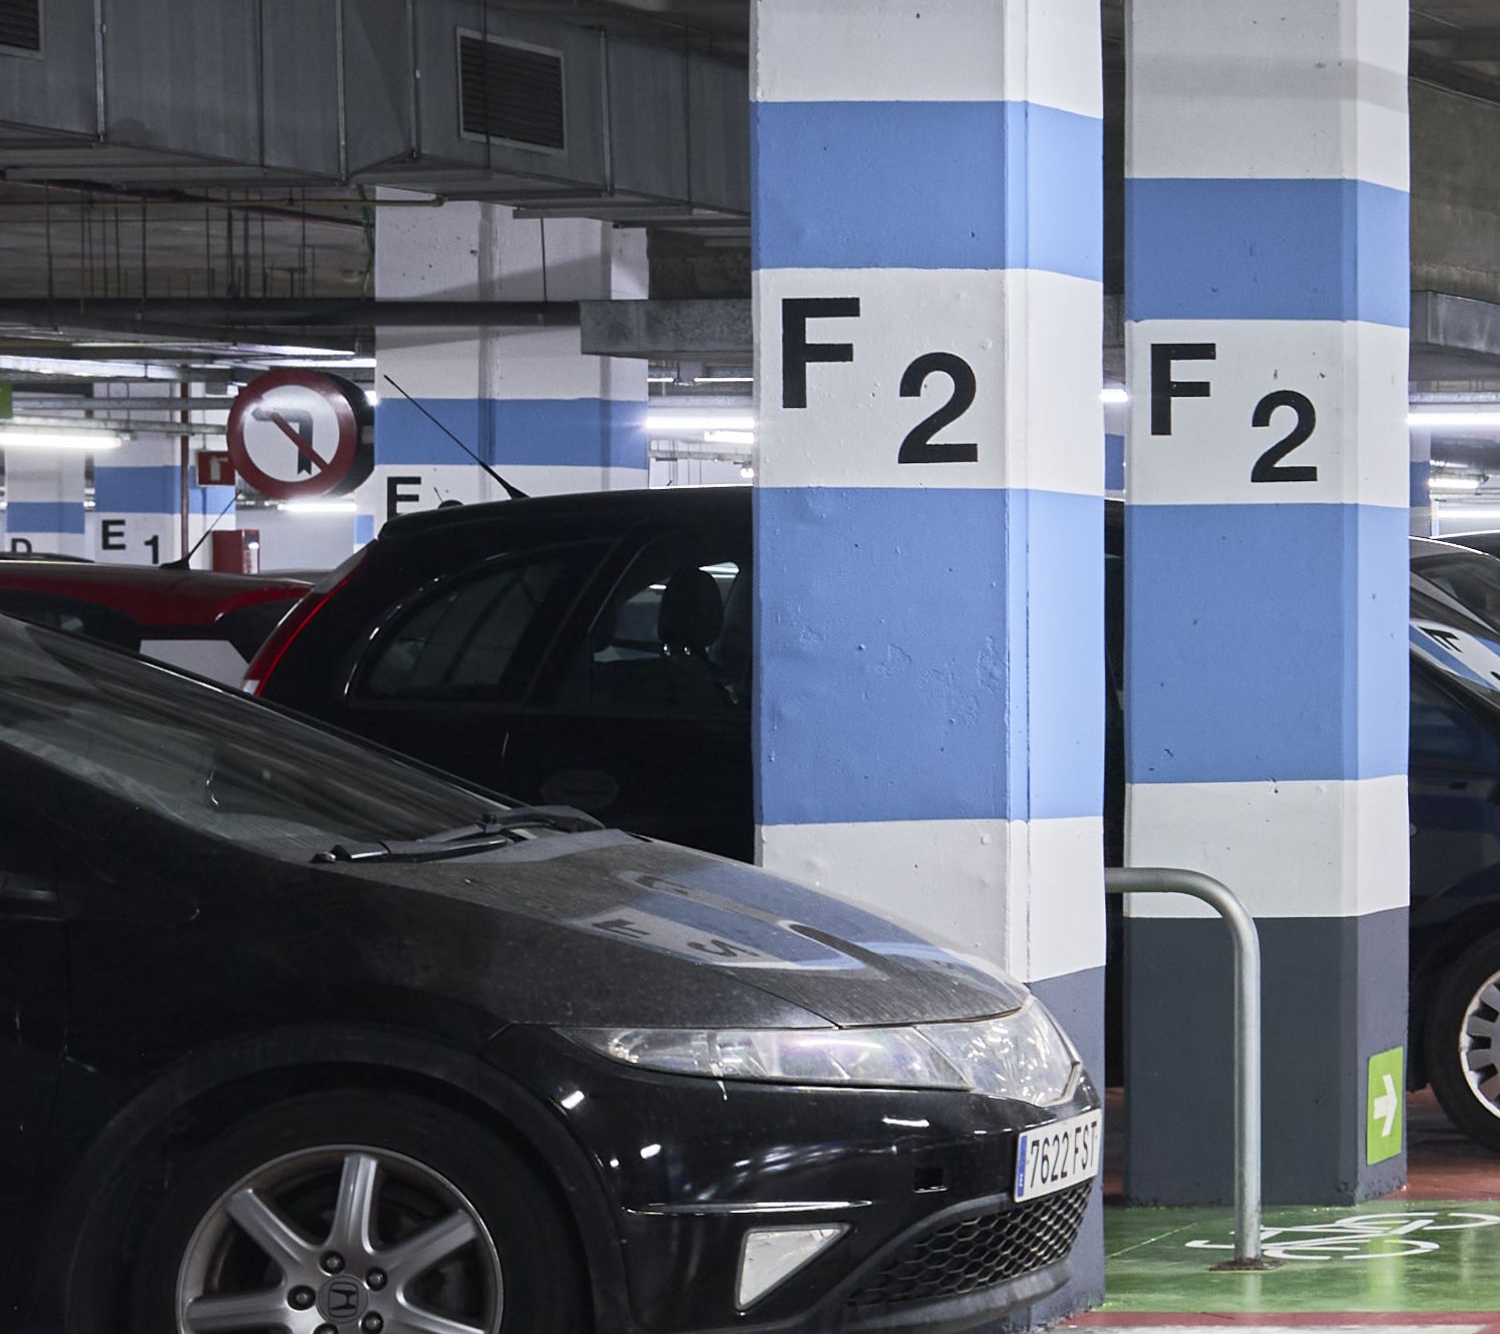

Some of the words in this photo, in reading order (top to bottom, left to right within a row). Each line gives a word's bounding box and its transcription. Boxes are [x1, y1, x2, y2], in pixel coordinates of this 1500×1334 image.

[781, 297, 861, 409] F
[897, 351, 978, 465] 2
[1150, 342, 1217, 436] F
[1250, 389, 1318, 483] 2
[101, 519, 127, 551] E
[144, 534, 159, 565] 1
[1030, 1131, 1070, 1189] 7622
[1072, 1120, 1098, 1175] FST
